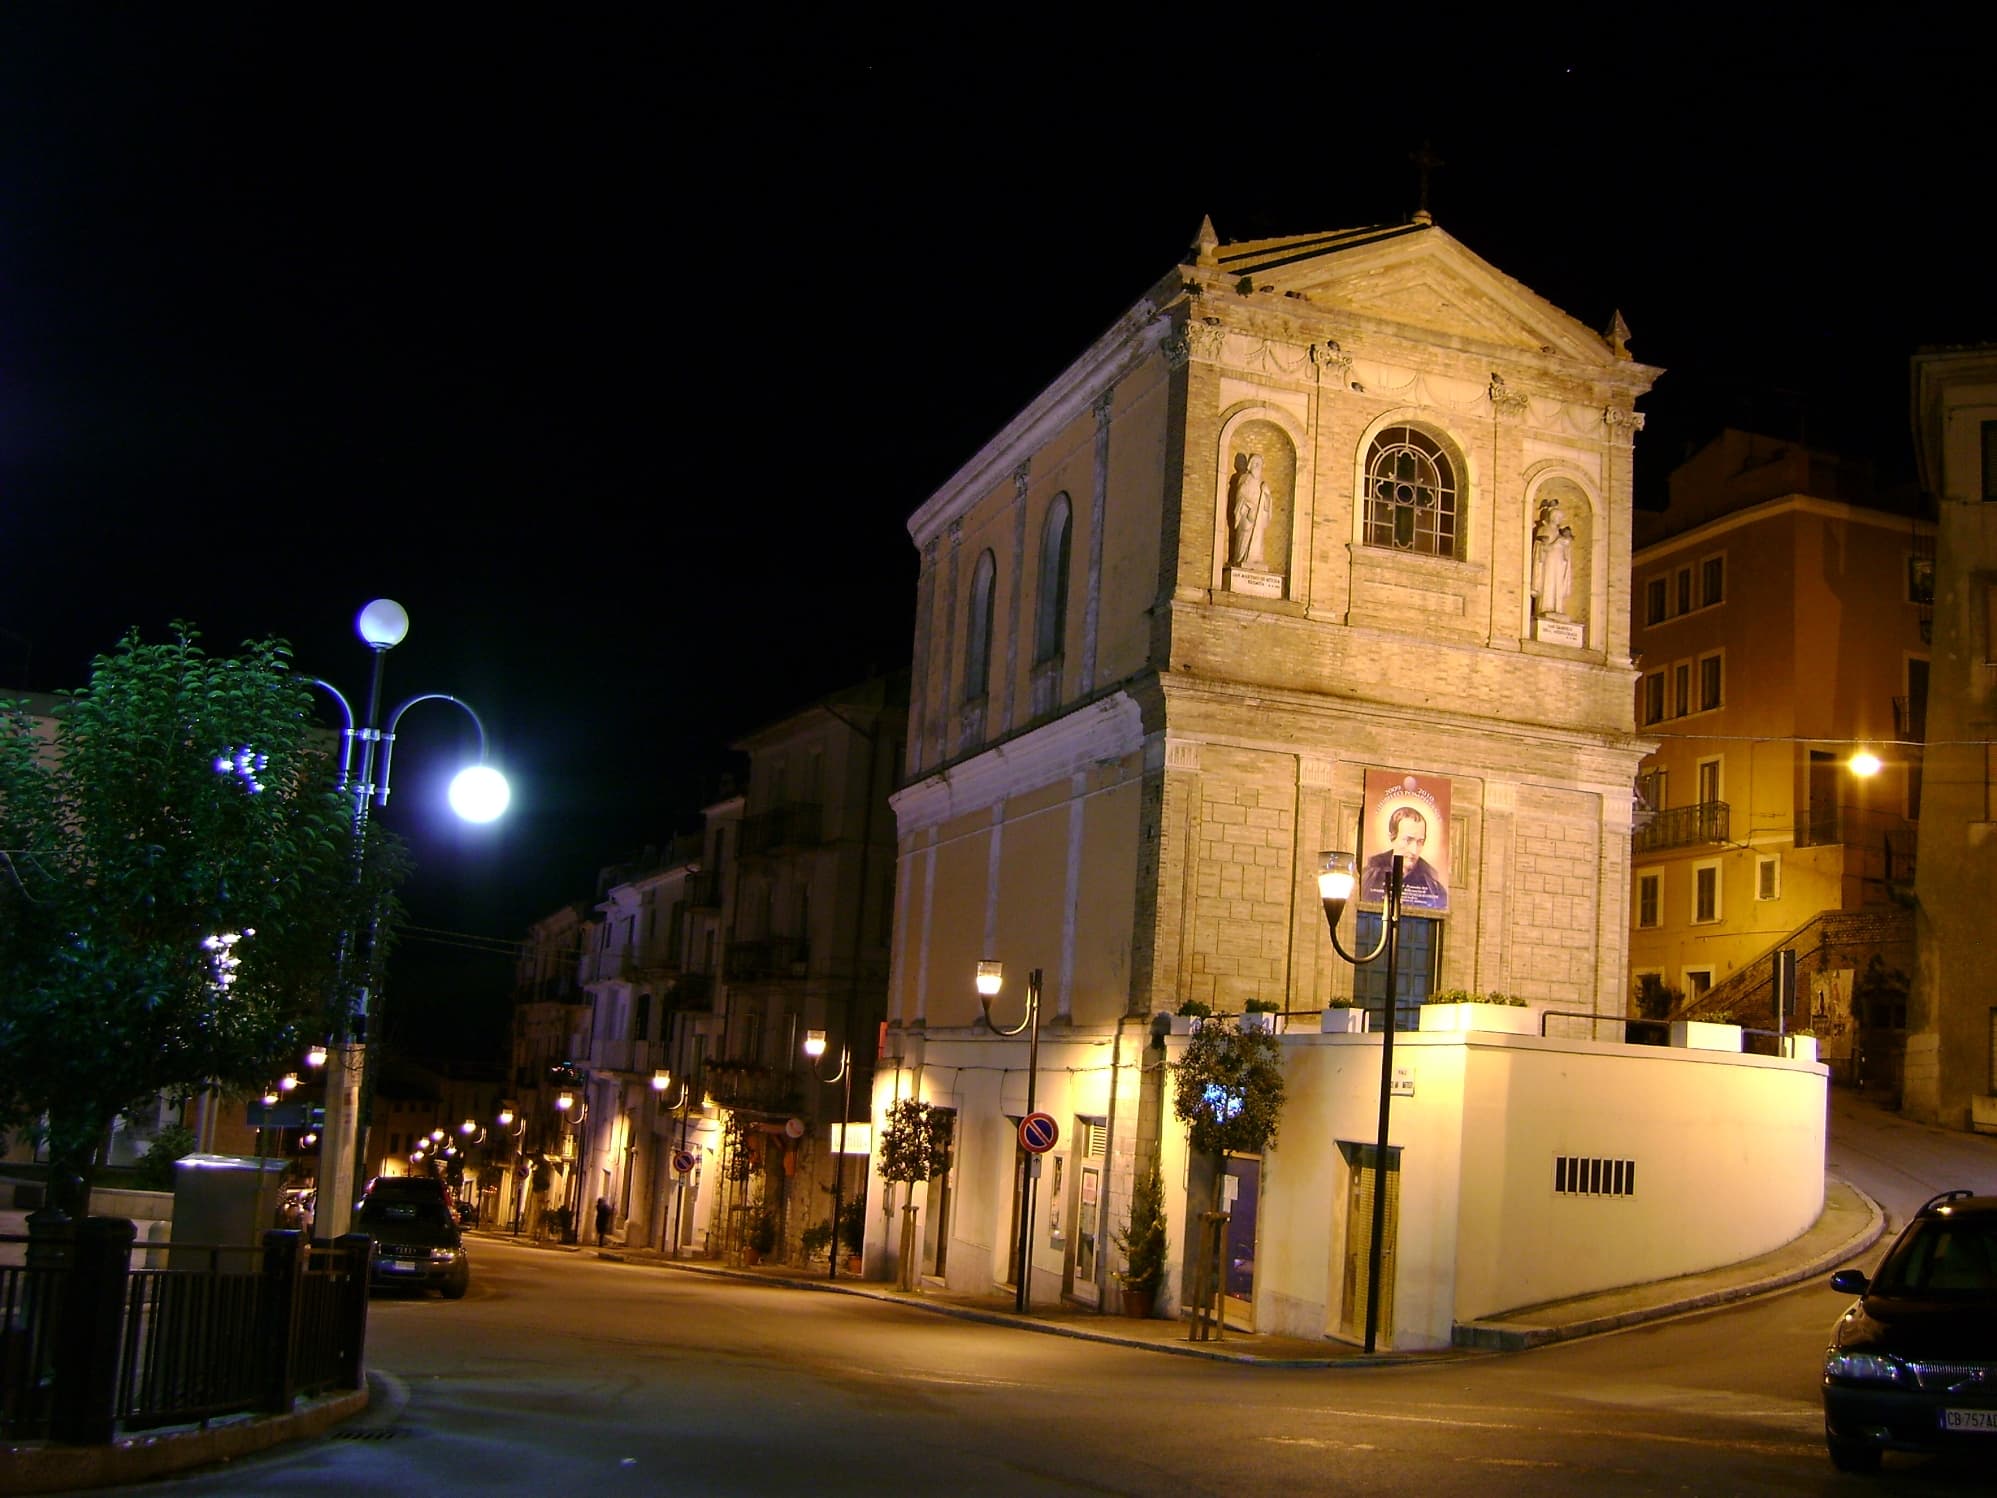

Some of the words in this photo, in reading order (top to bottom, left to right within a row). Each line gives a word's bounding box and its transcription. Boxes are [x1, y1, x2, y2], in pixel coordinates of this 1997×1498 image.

[1384, 784, 1402, 796] 2009
[1416, 787, 1435, 802] 2010
[1947, 1411, 1961, 1426] CB
